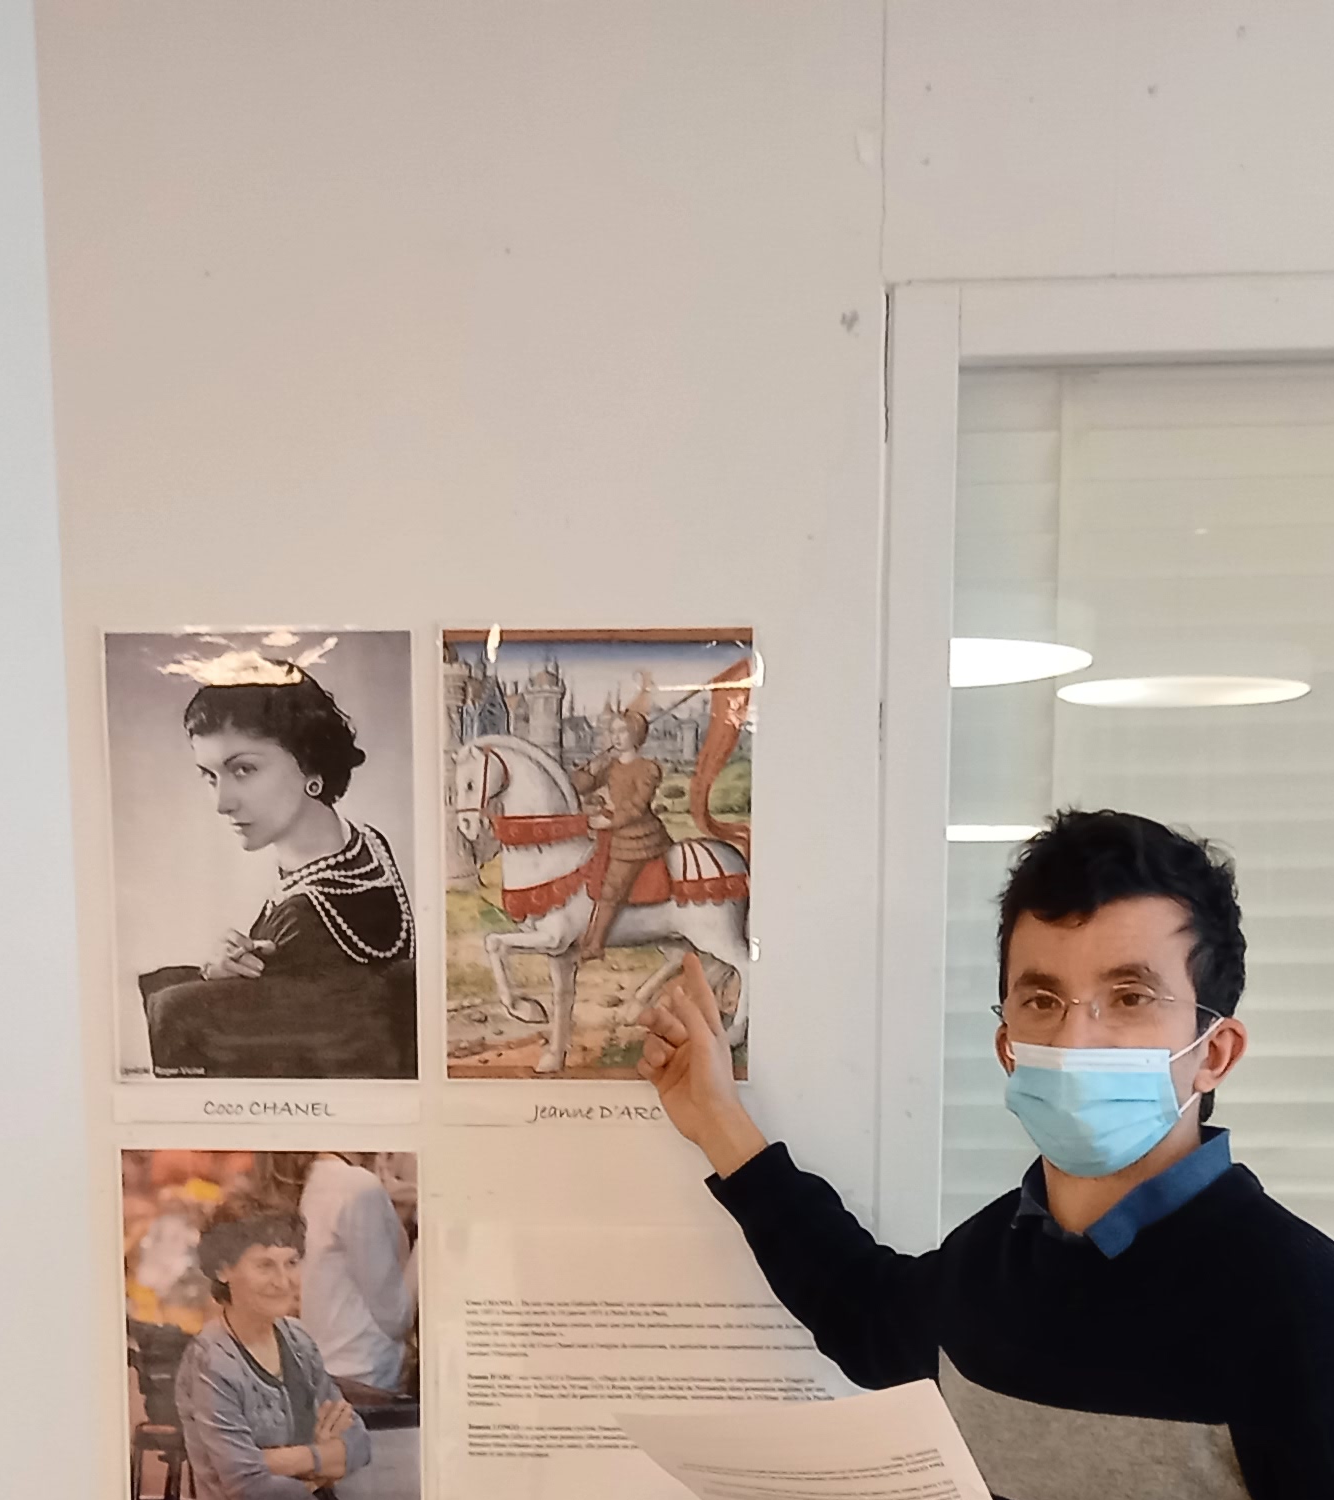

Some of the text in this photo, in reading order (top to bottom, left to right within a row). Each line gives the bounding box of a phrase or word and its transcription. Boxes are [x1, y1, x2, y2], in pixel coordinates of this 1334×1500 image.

[203, 1100, 337, 1117] Coco CHANEL
[524, 1104, 595, 1124] Jeanne
